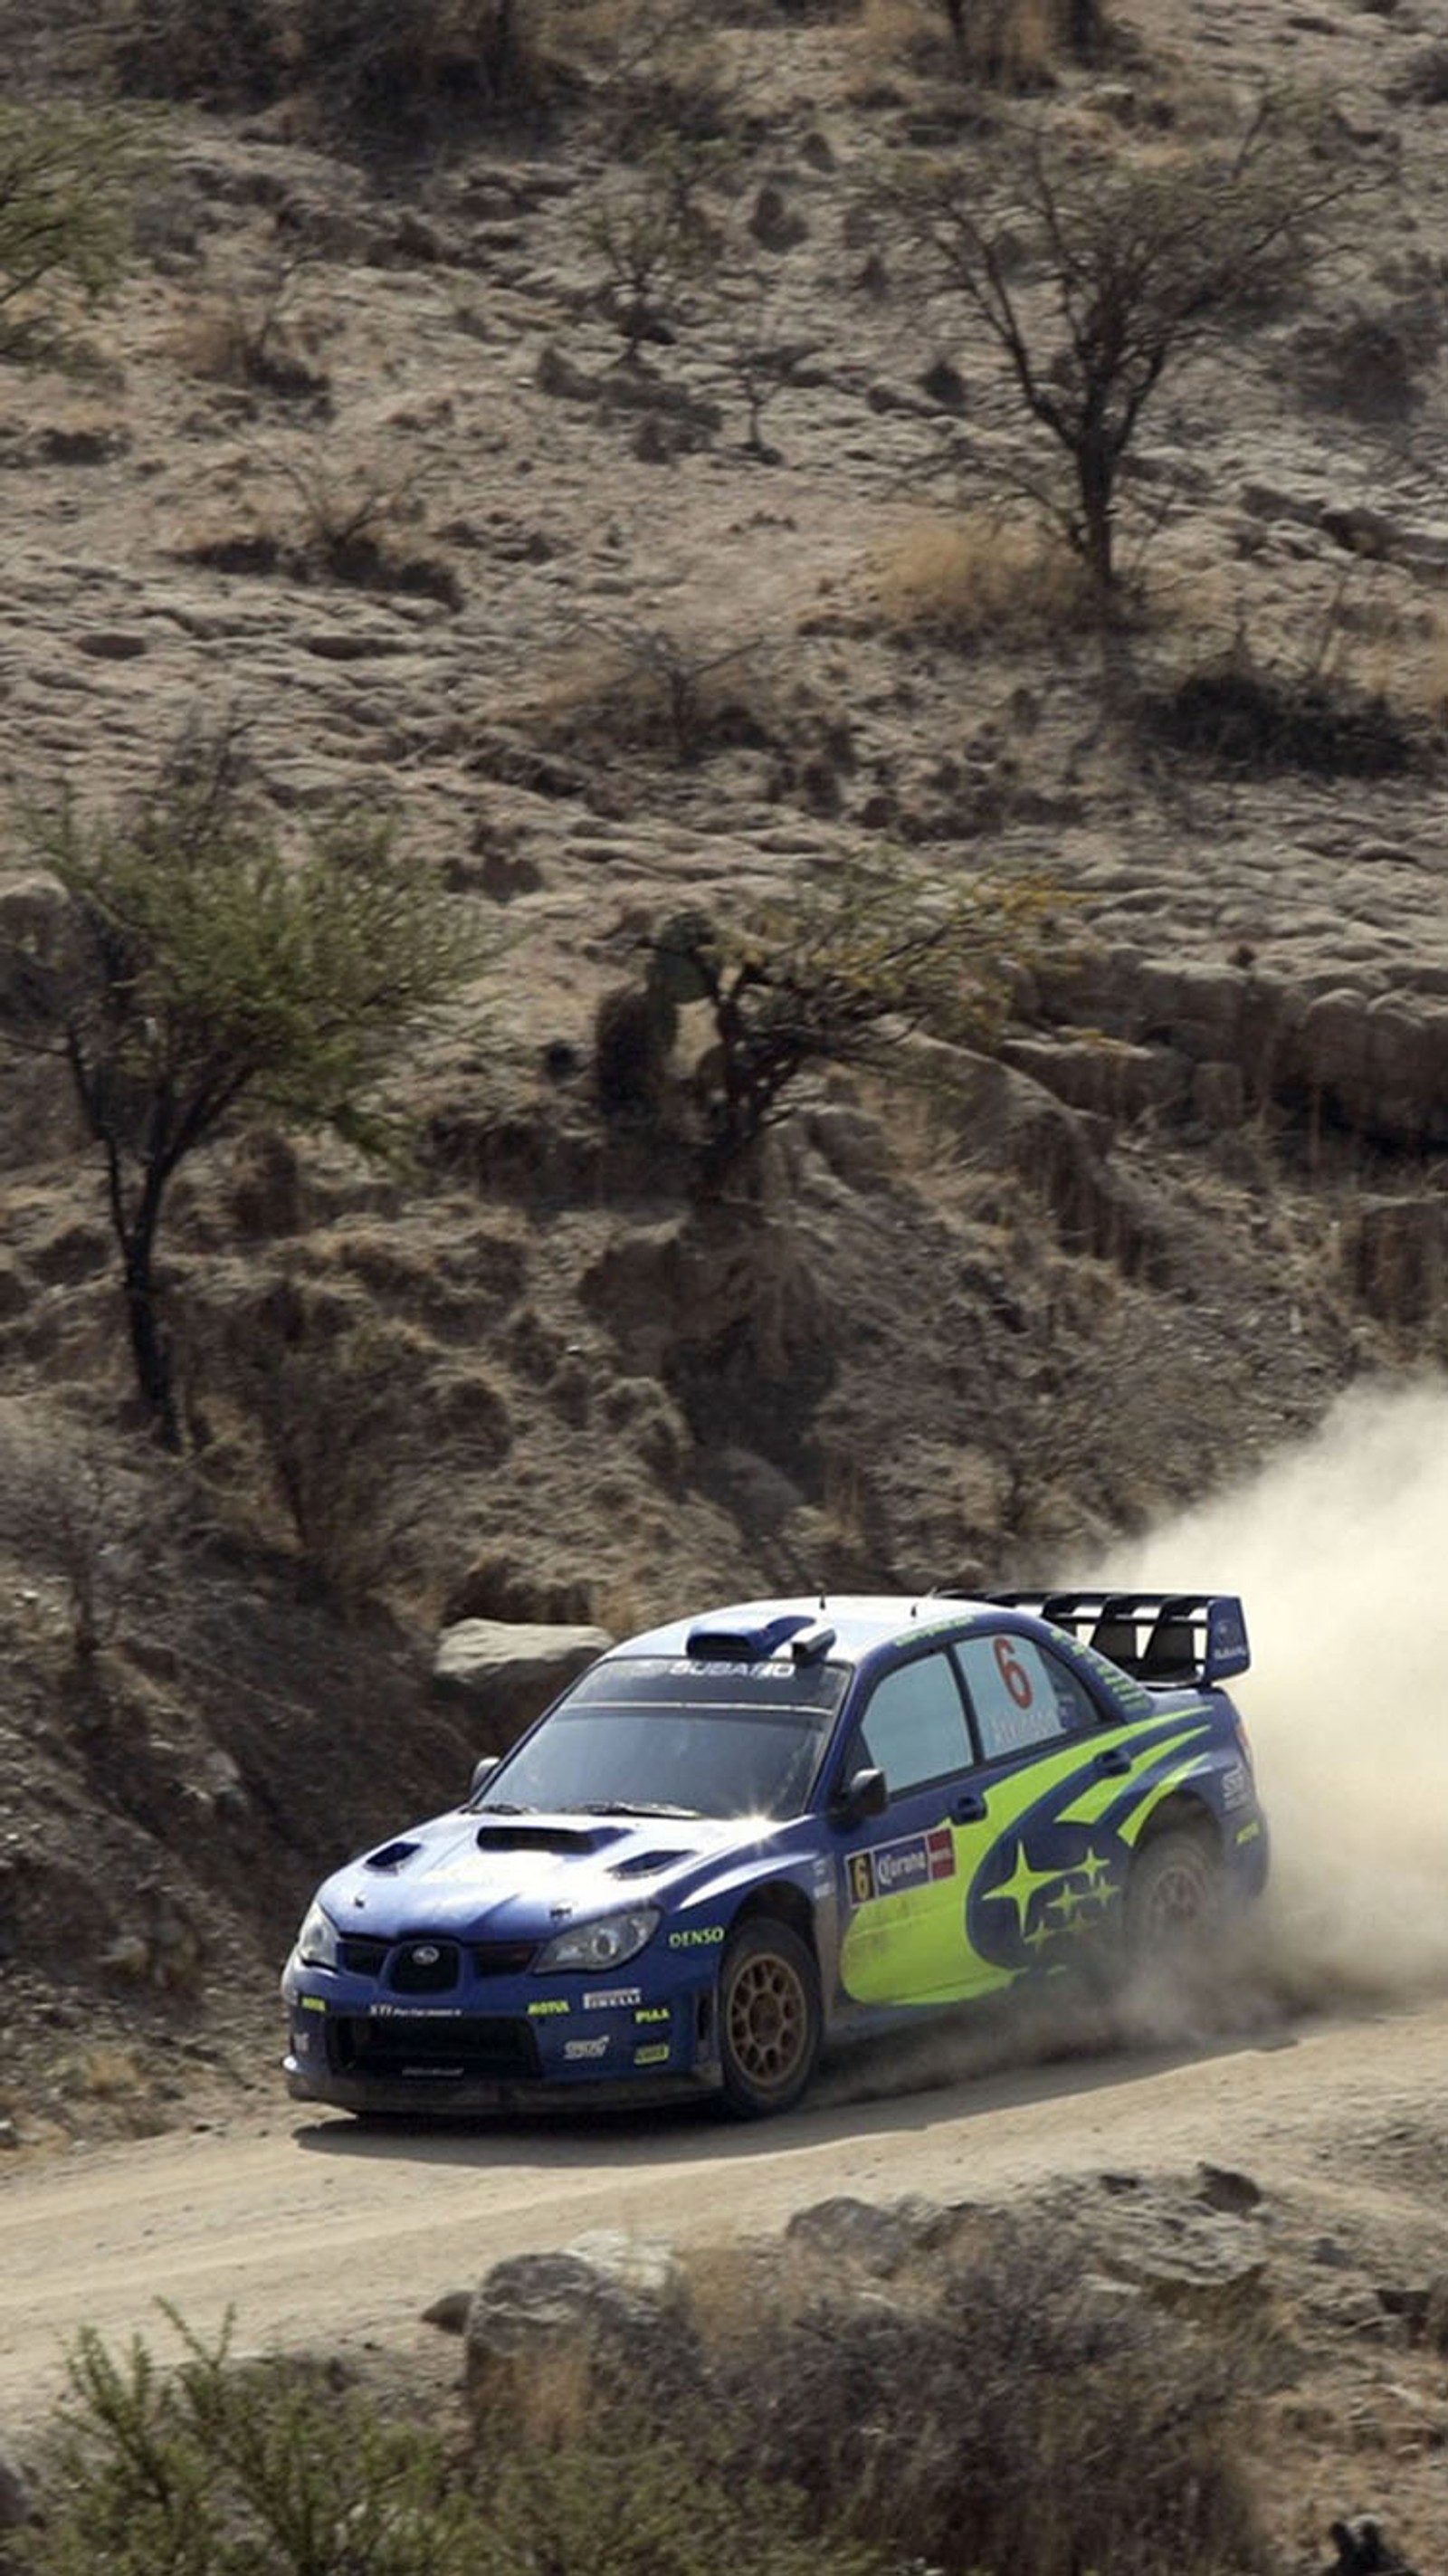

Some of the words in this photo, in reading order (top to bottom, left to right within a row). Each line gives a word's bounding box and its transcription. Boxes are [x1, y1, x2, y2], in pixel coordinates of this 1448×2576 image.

[993, 1636, 1034, 1710] 6
[853, 1856, 871, 1901] 6
[878, 1852, 927, 1885] Corona
[668, 1926, 725, 1947] DENSO
[583, 1988, 642, 2008] PIRELLI
[635, 2008, 671, 2023] PIAA
